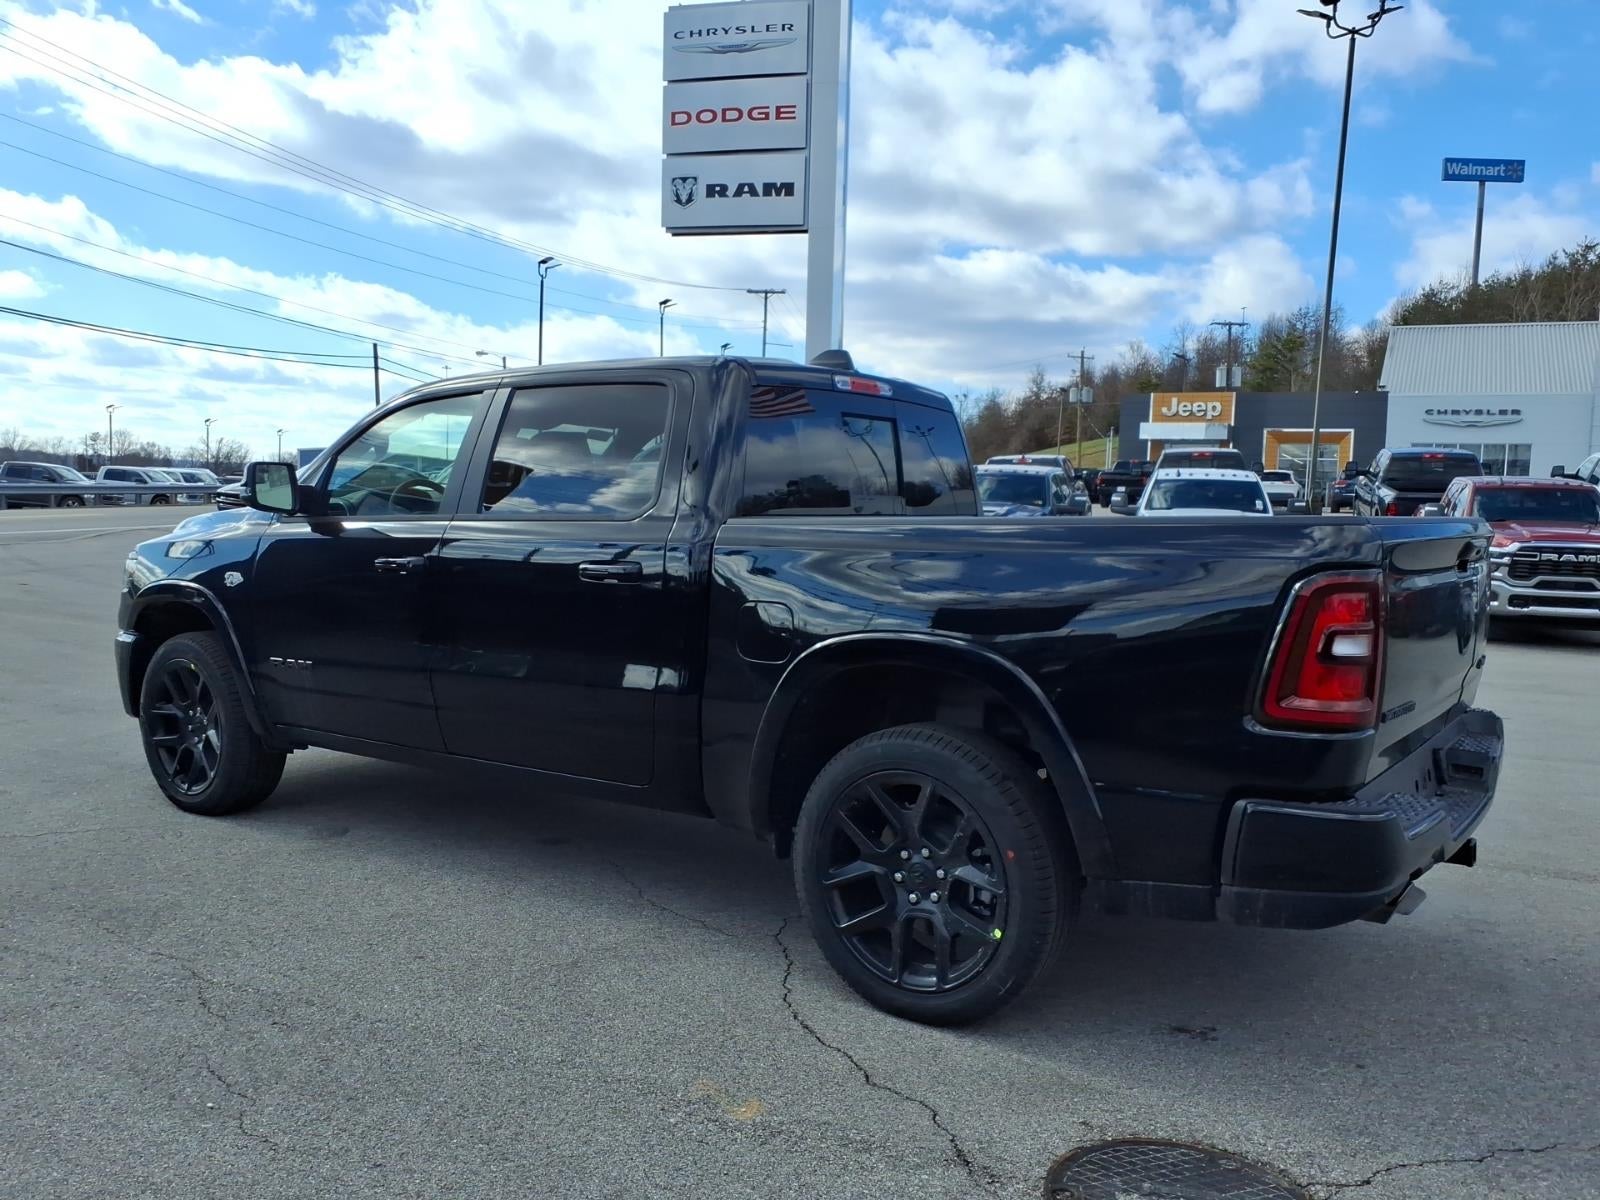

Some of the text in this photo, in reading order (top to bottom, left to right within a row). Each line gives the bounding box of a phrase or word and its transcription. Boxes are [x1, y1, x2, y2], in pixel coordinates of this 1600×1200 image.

[673, 23, 795, 40] CHRYSLER
[670, 104, 797, 127] DODGE
[1446, 162, 1506, 176] Walmart
[705, 182, 795, 198] RAM
[1161, 397, 1222, 420] Jeep
[1424, 408, 1522, 416] CHRYSLER
[1541, 553, 1597, 562] RAM
